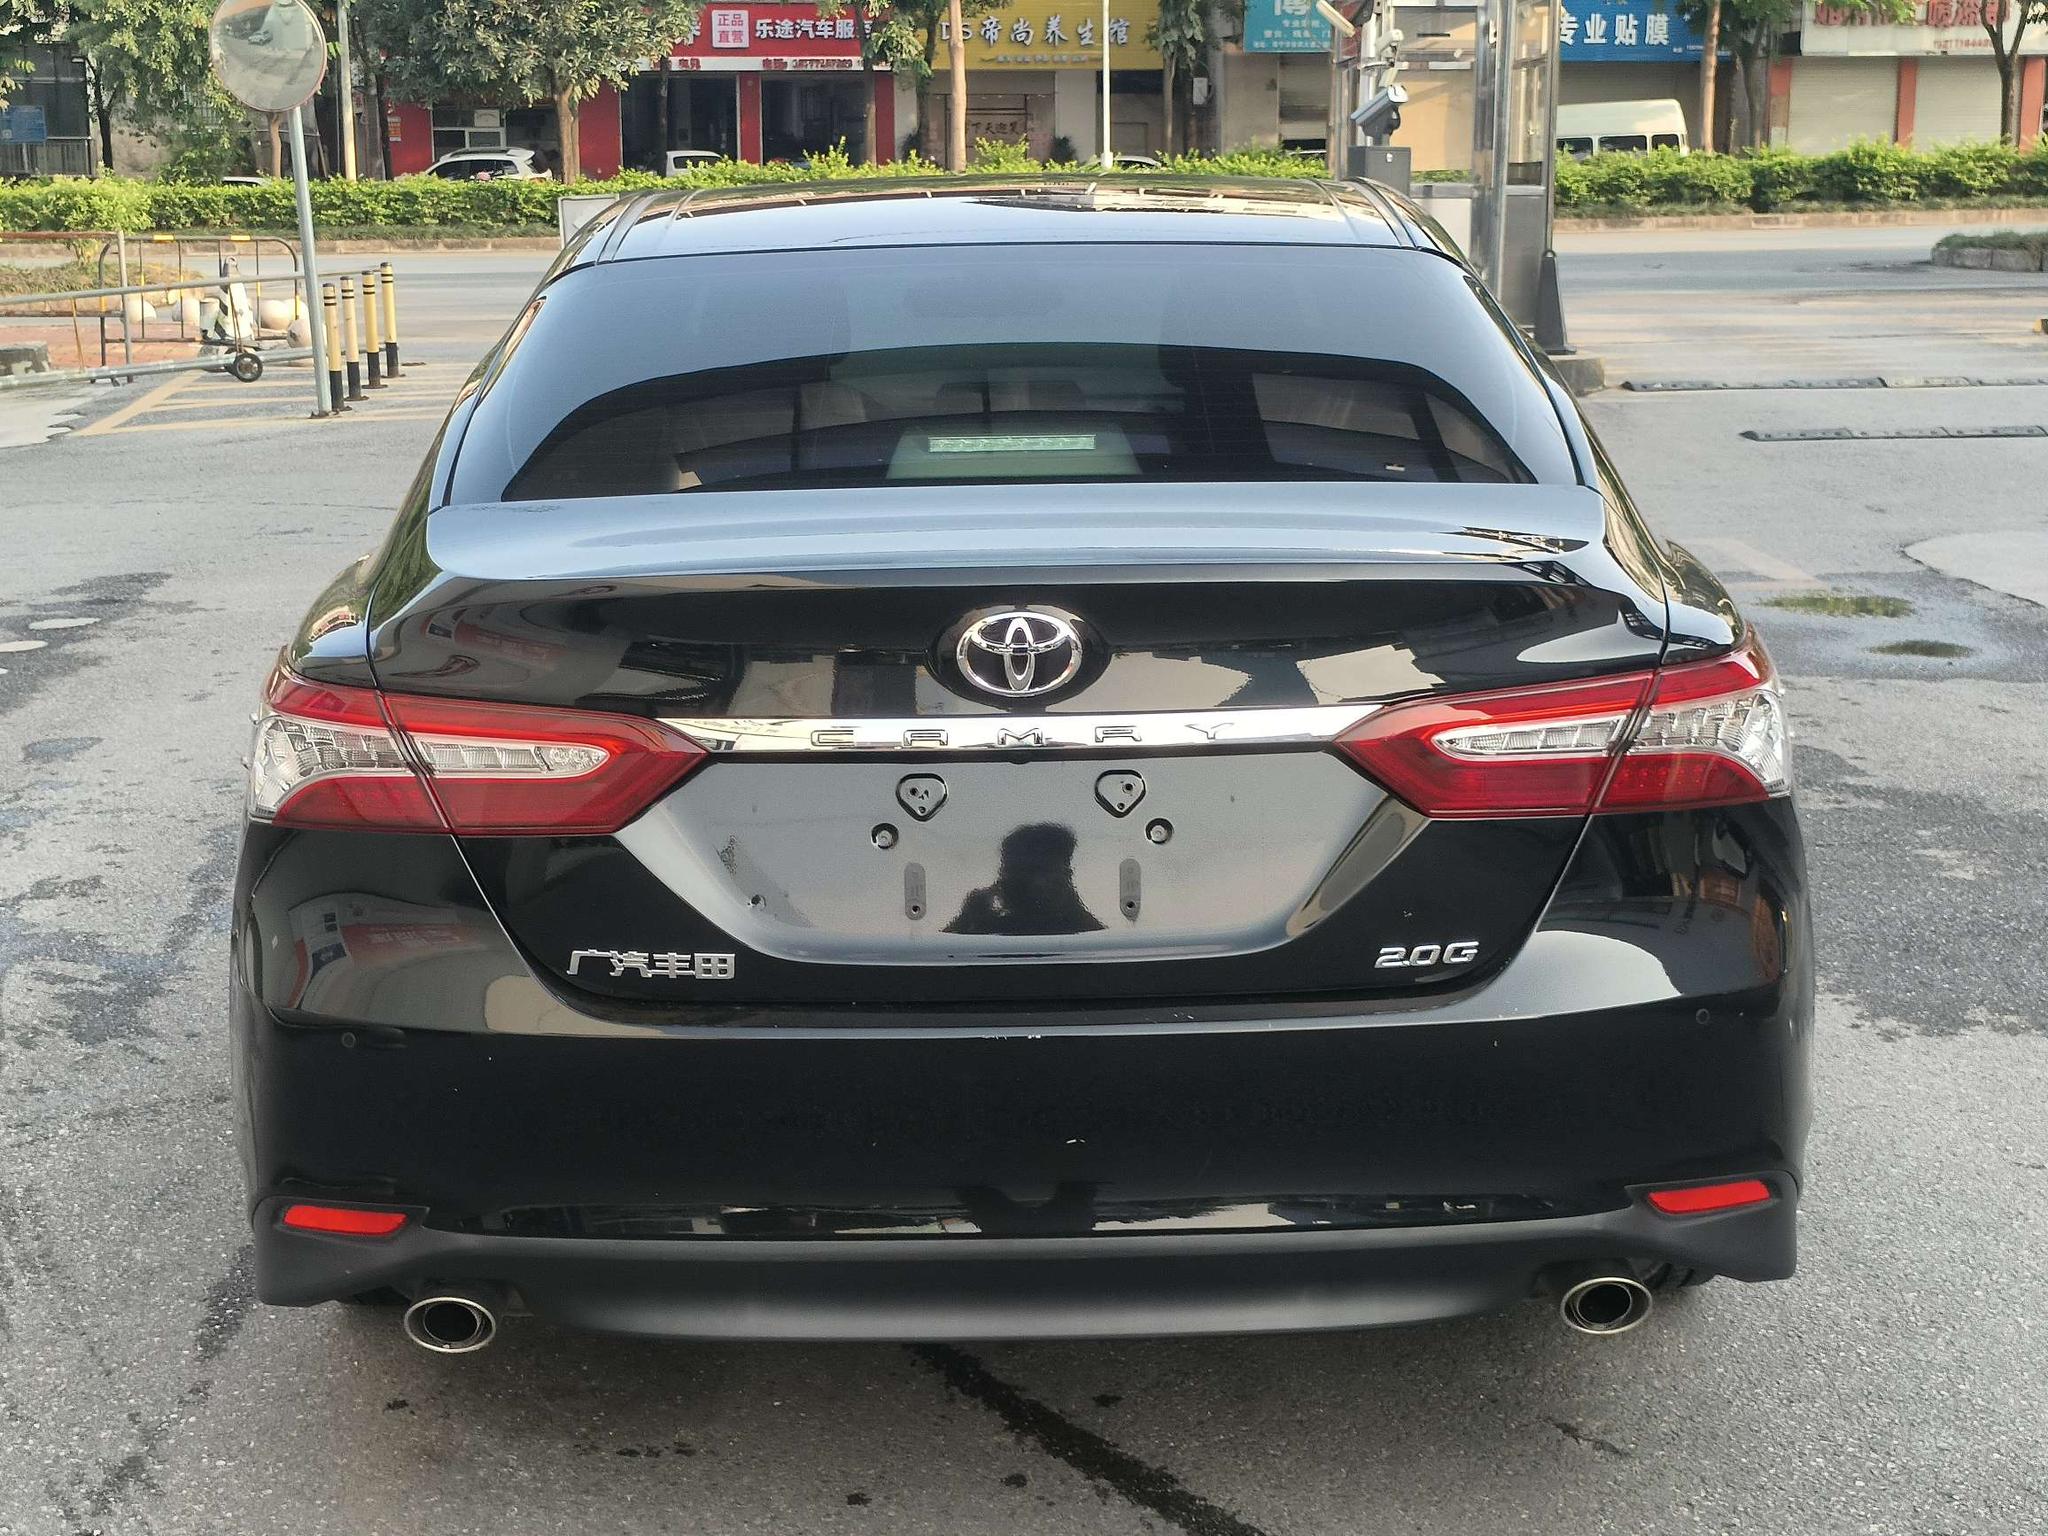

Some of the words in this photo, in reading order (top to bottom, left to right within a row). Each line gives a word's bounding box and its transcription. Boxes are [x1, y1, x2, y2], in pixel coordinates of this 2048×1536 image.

[717, 13, 744, 27] 正品
[980, 14, 1131, 47] 帝尚养生馆
[1561, 12, 1670, 46] 专业贴膜
[809, 721, 1235, 748] CAMRY
[566, 948, 736, 980] 广汽丰田
